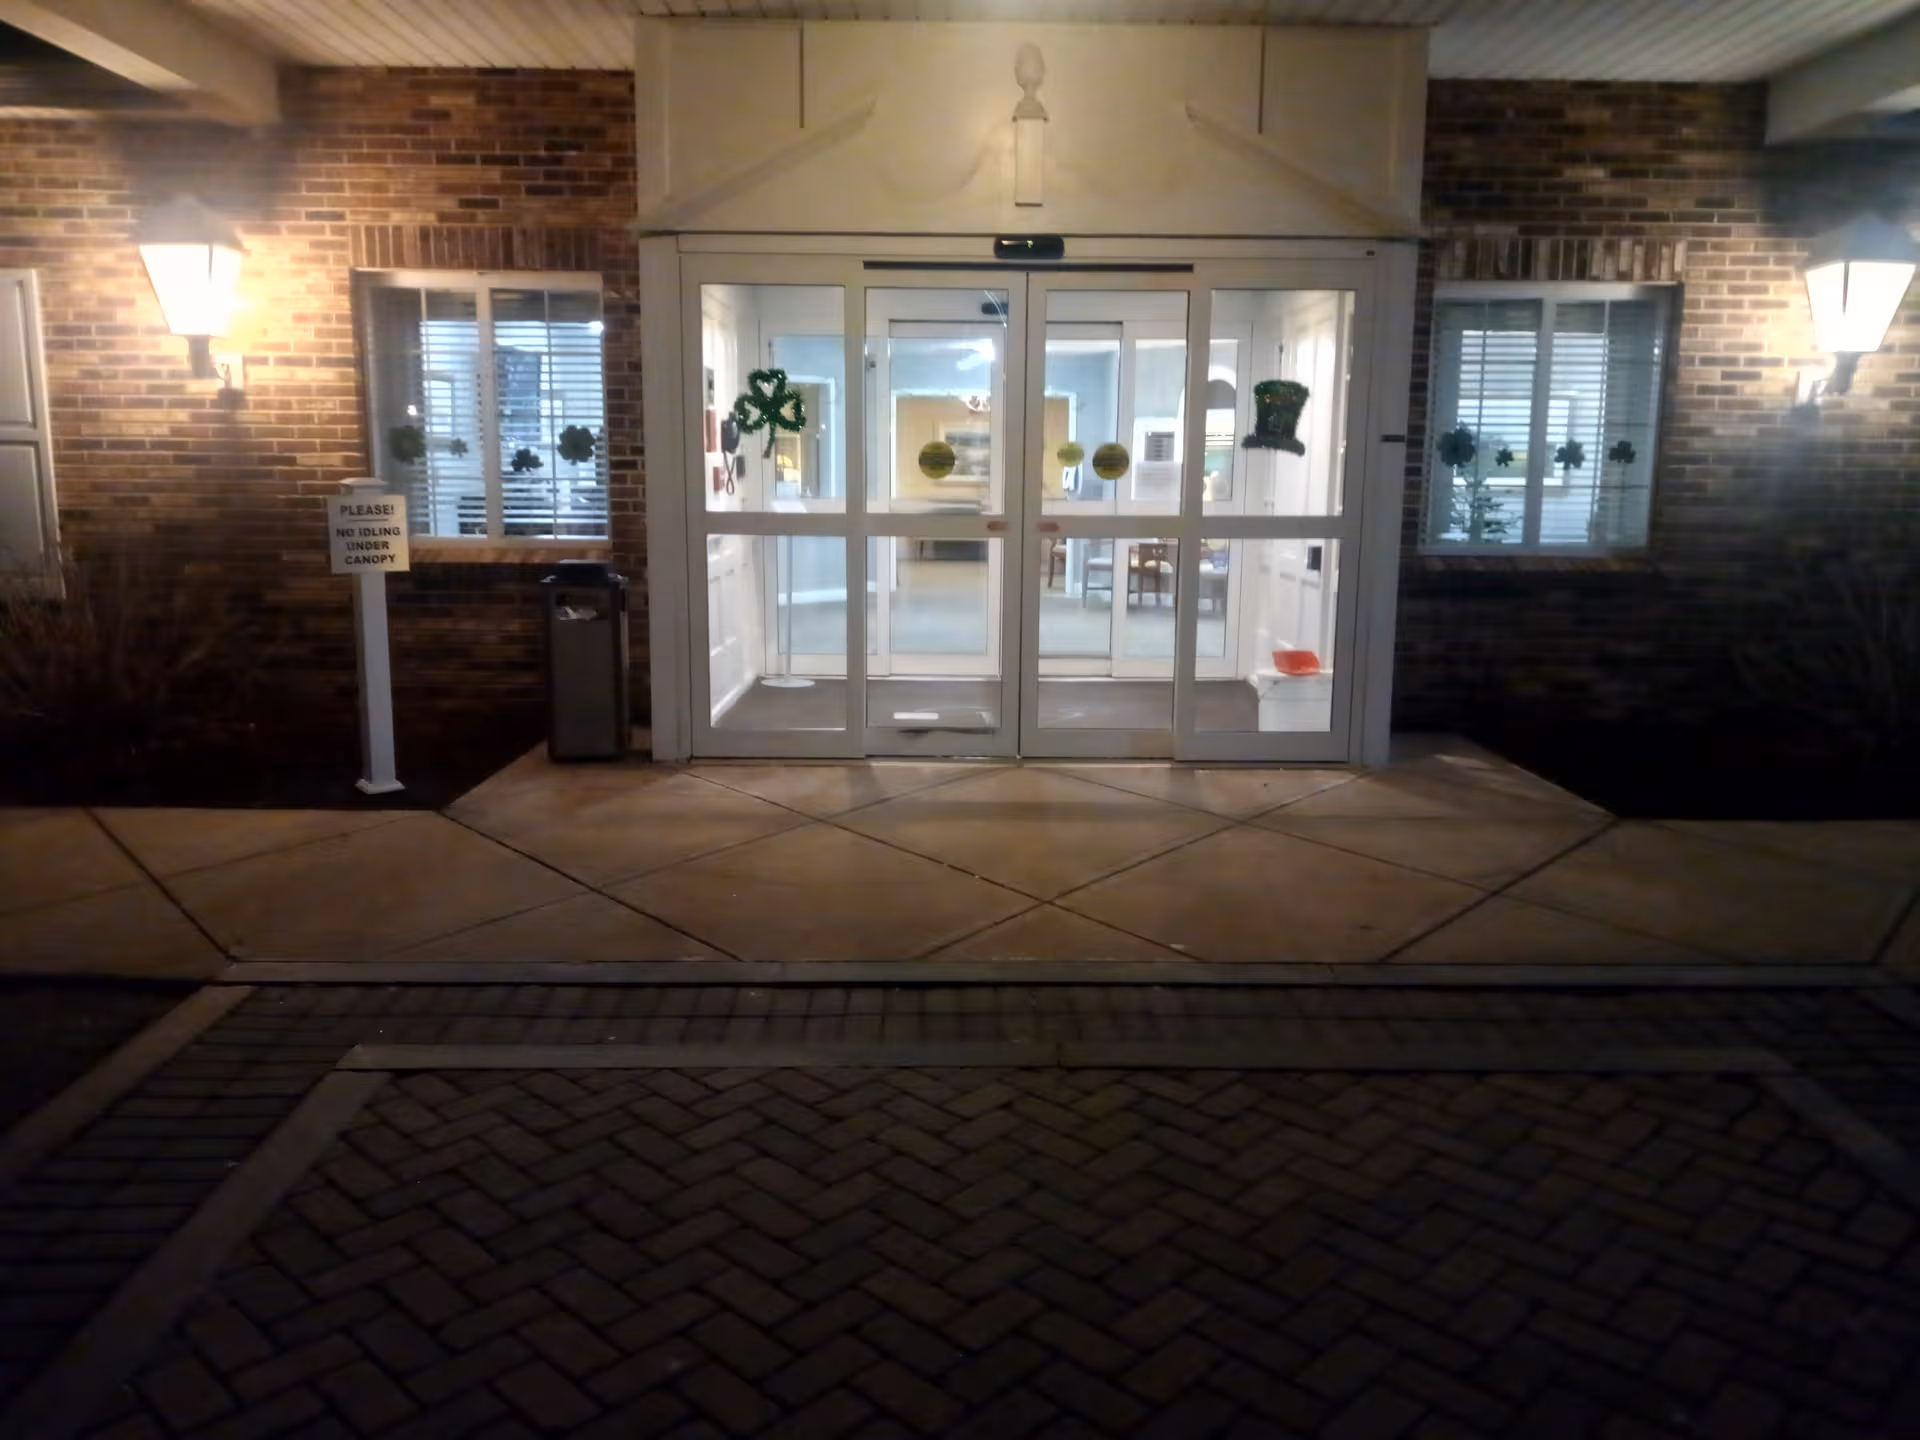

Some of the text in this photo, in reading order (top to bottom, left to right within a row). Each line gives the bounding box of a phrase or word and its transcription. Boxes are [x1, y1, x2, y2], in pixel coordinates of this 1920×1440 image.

[340, 504, 395, 516] PLEASE!
[336, 527, 401, 538] NO IDLING
[346, 541, 390, 551] UNDER
[345, 554, 396, 565] CANOPY
